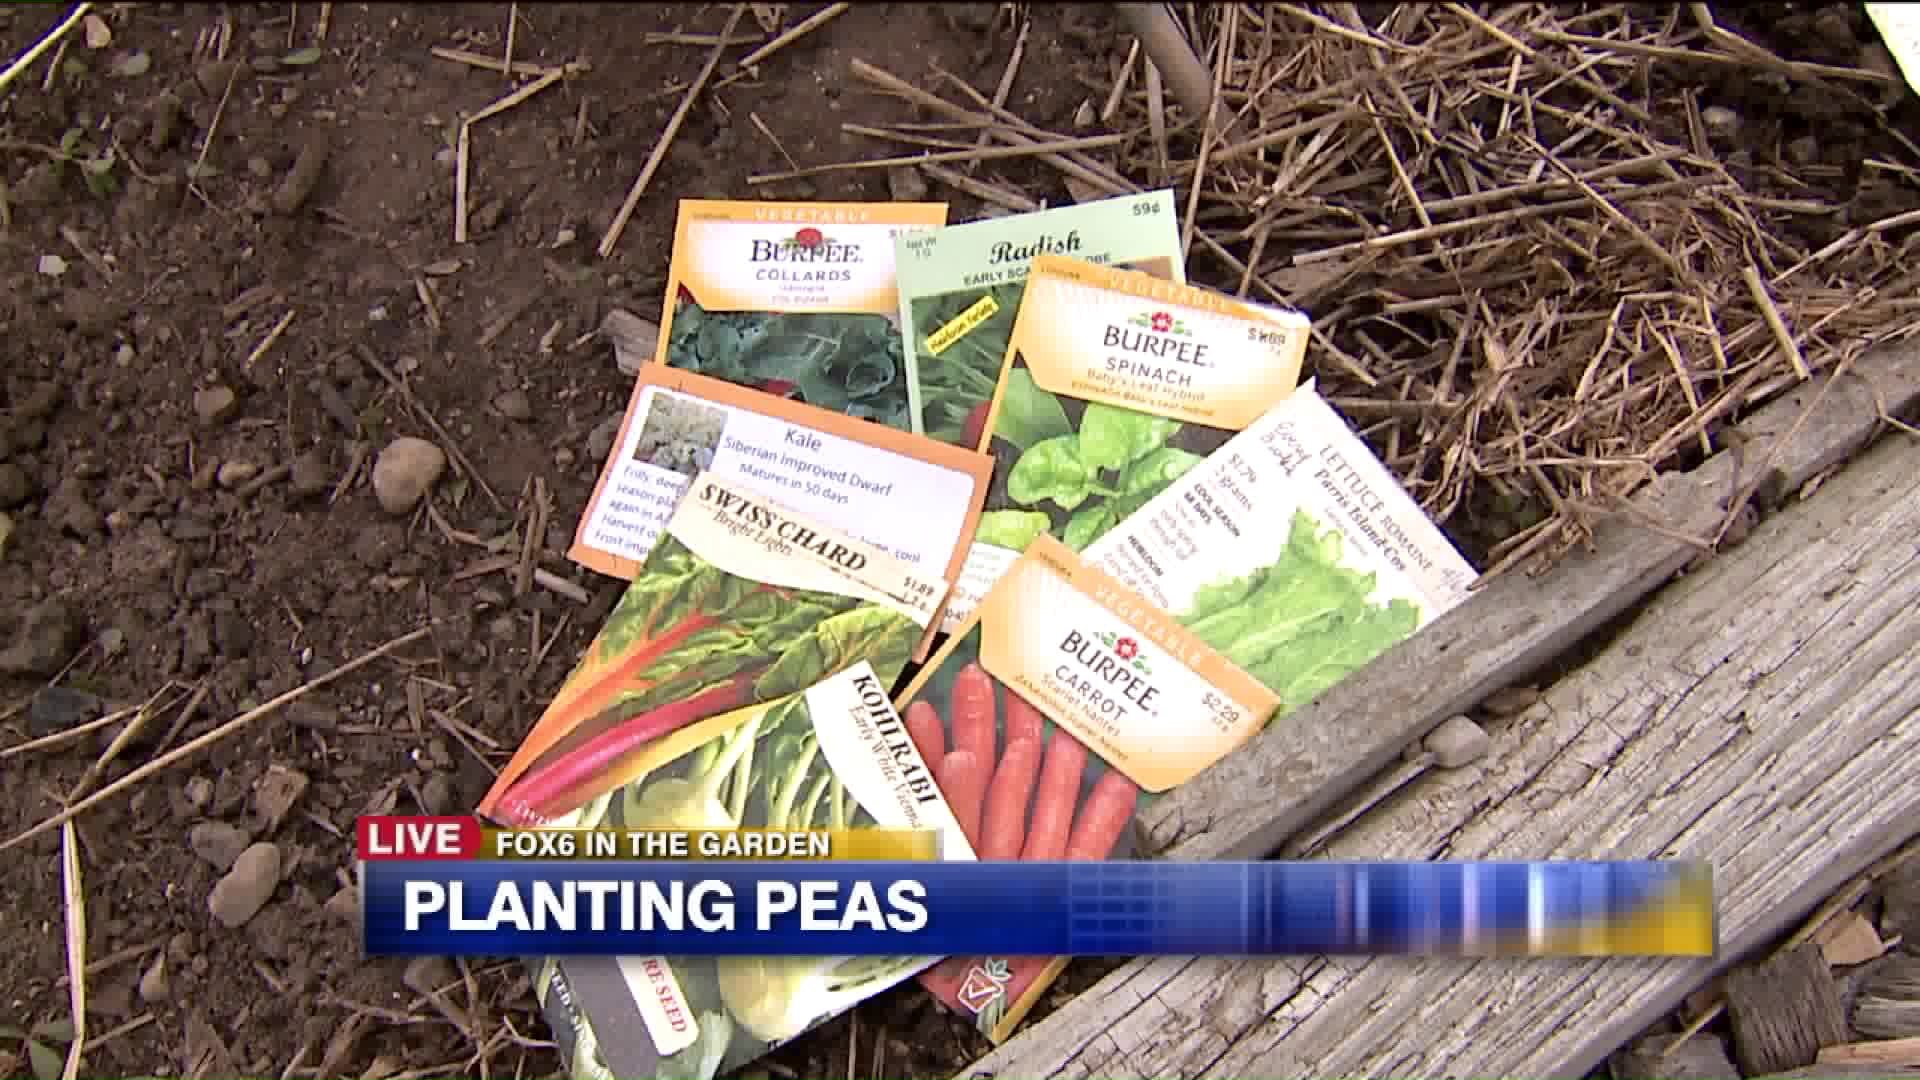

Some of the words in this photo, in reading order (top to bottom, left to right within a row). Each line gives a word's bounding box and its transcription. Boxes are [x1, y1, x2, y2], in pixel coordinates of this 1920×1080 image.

[1132, 201, 1161, 216] 59¢
[989, 230, 1082, 264] Radish
[756, 268, 851, 281] COLLARDS
[963, 269, 1003, 286] EARLY
[1007, 266, 1032, 279] SCA
[1106, 357, 1191, 388] SPINACH
[784, 427, 822, 452] Kale
[723, 436, 777, 464] Siberian
[780, 454, 847, 484] Improved
[849, 473, 893, 497] Dwarf
[739, 463, 789, 485] Matures
[791, 479, 802, 489] in
[805, 481, 820, 495] 50
[822, 486, 849, 504] days
[699, 483, 778, 529] SWISS
[776, 519, 867, 571] CHARD
[1314, 468, 1350, 508] Parris
[1350, 506, 1386, 548] Island
[1384, 546, 1407, 570] Cos
[1320, 444, 1384, 513] LETTUCE
[1381, 515, 1433, 570] ROMAINE
[713, 508, 754, 538] Bright
[753, 527, 794, 556] Lights
[1056, 665, 1128, 721] CARROT
[1202, 691, 1240, 723] $2.29
[849, 705, 874, 741] Early
[853, 674, 938, 804] KOHLRABI
[655, 984, 688, 1032] SEED
